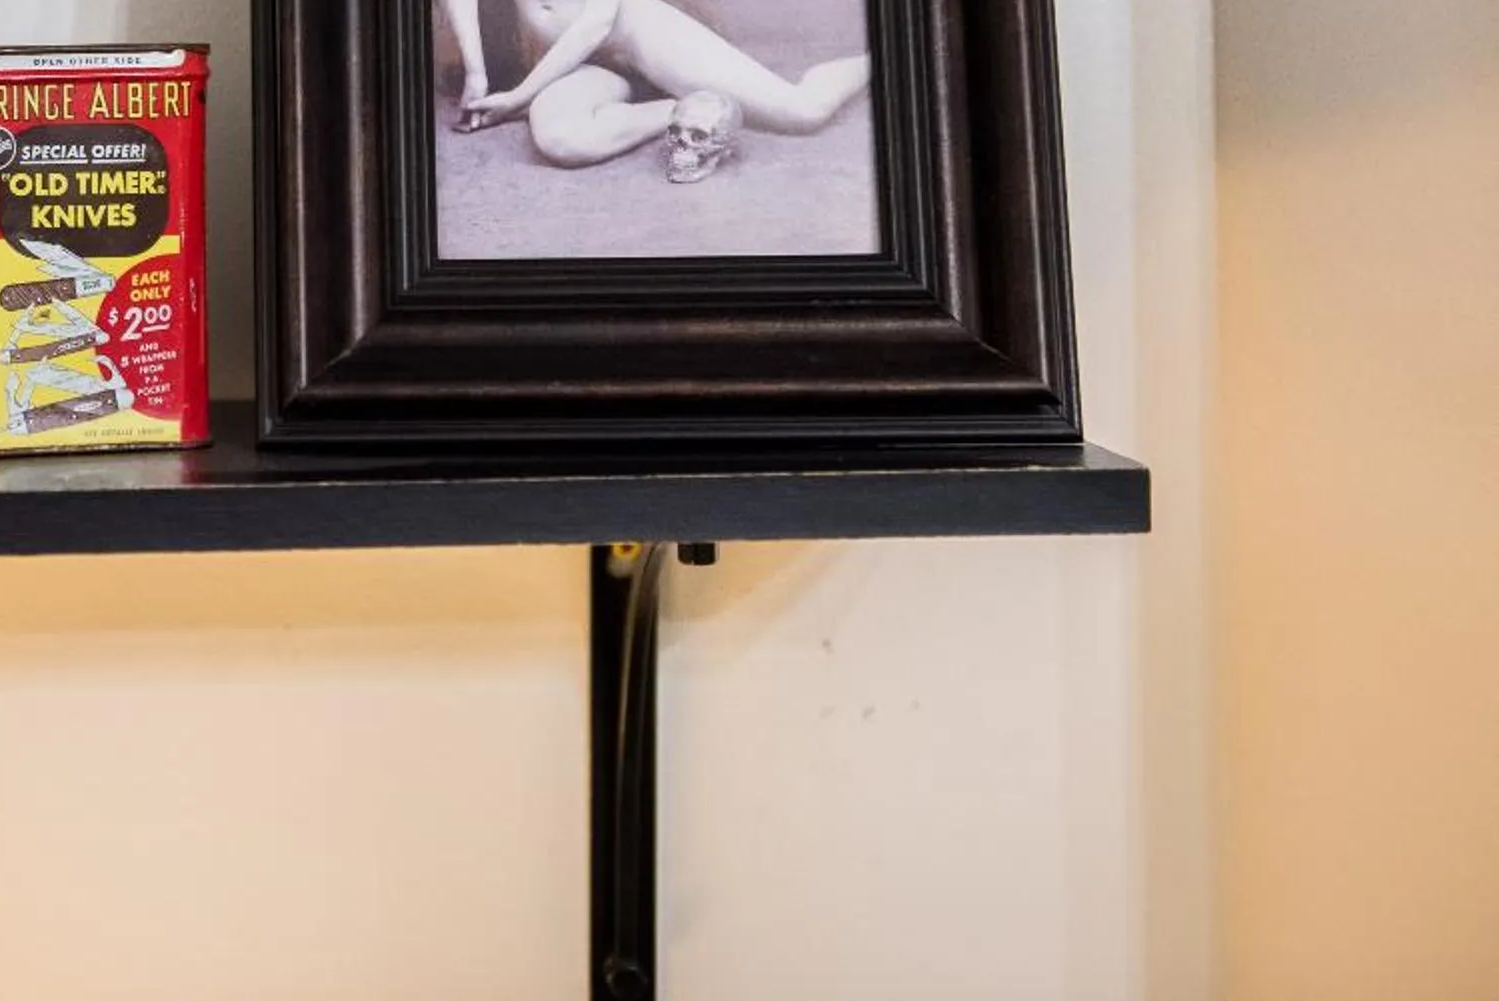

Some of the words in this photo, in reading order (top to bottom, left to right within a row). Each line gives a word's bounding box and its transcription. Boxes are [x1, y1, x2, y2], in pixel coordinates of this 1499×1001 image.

[89, 81, 191, 118] ALBERT
[21, 145, 87, 160] SPECIAL
[91, 143, 147, 160] OFFER!
[31, 204, 138, 229] KNIVES
[131, 270, 170, 286] EACH
[130, 287, 171, 302] ONLY
